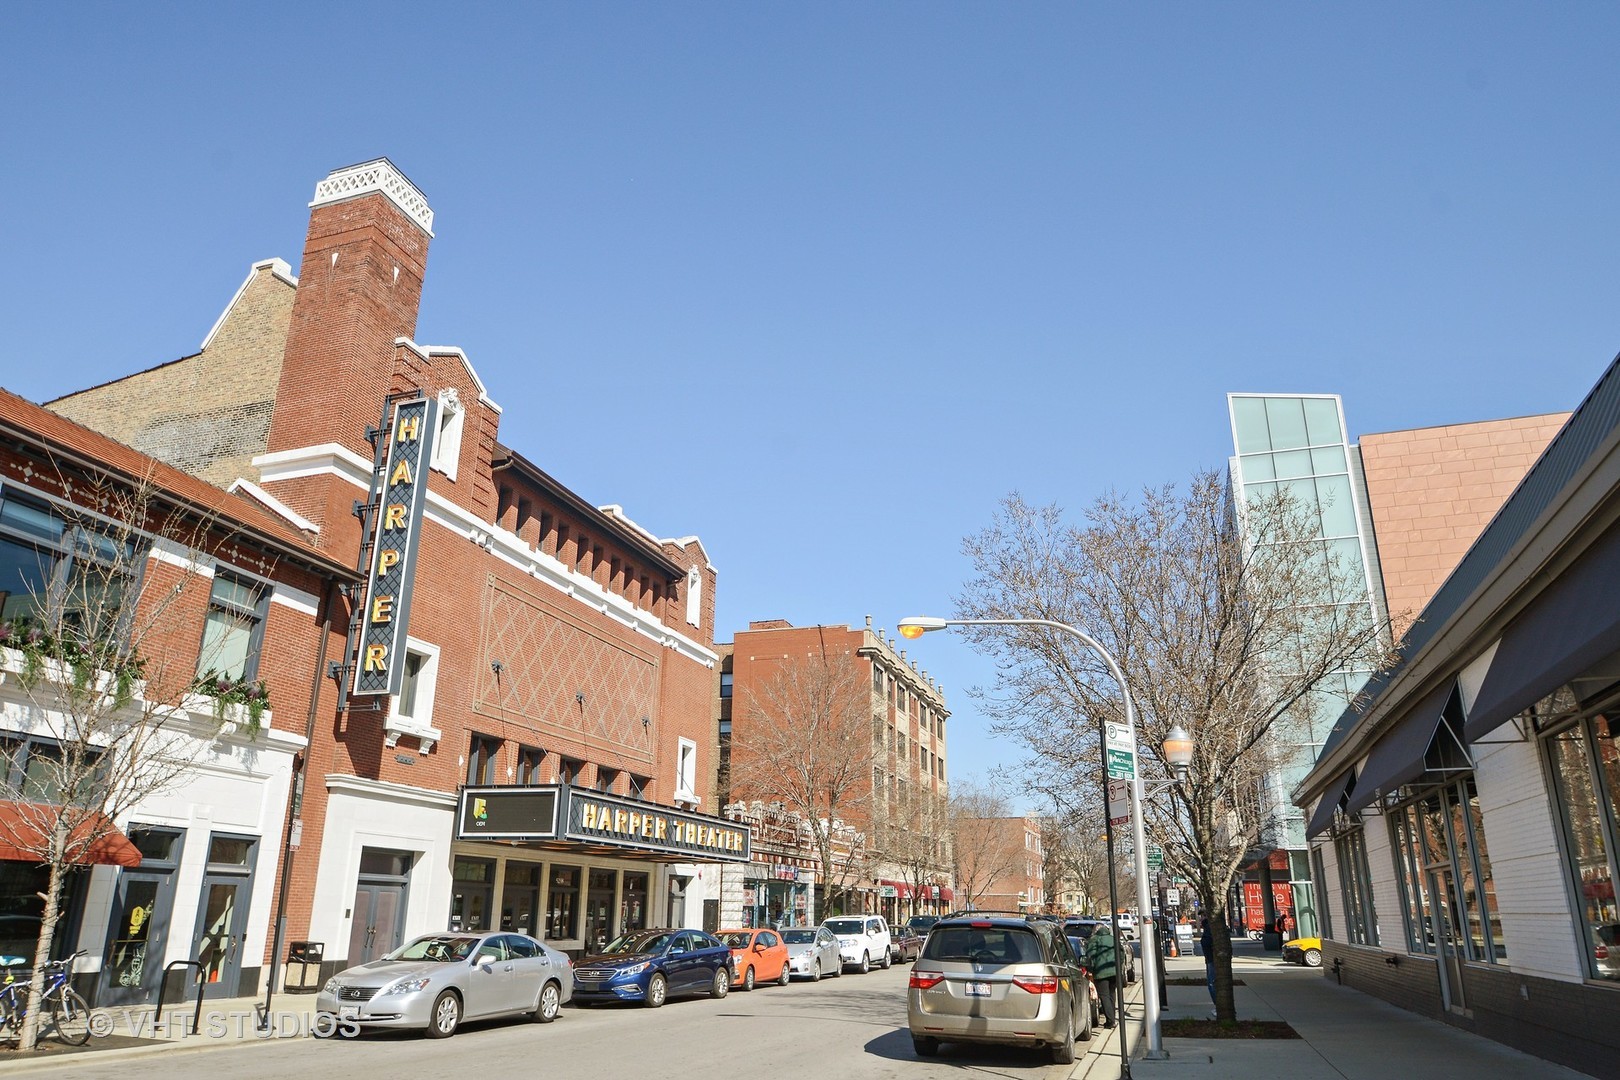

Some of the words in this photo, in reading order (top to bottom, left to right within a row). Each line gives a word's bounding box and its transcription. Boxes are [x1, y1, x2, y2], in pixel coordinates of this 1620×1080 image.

[364, 416, 420, 674] HARPER
[582, 803, 667, 840] HARPER
[673, 820, 743, 852] THEATER
